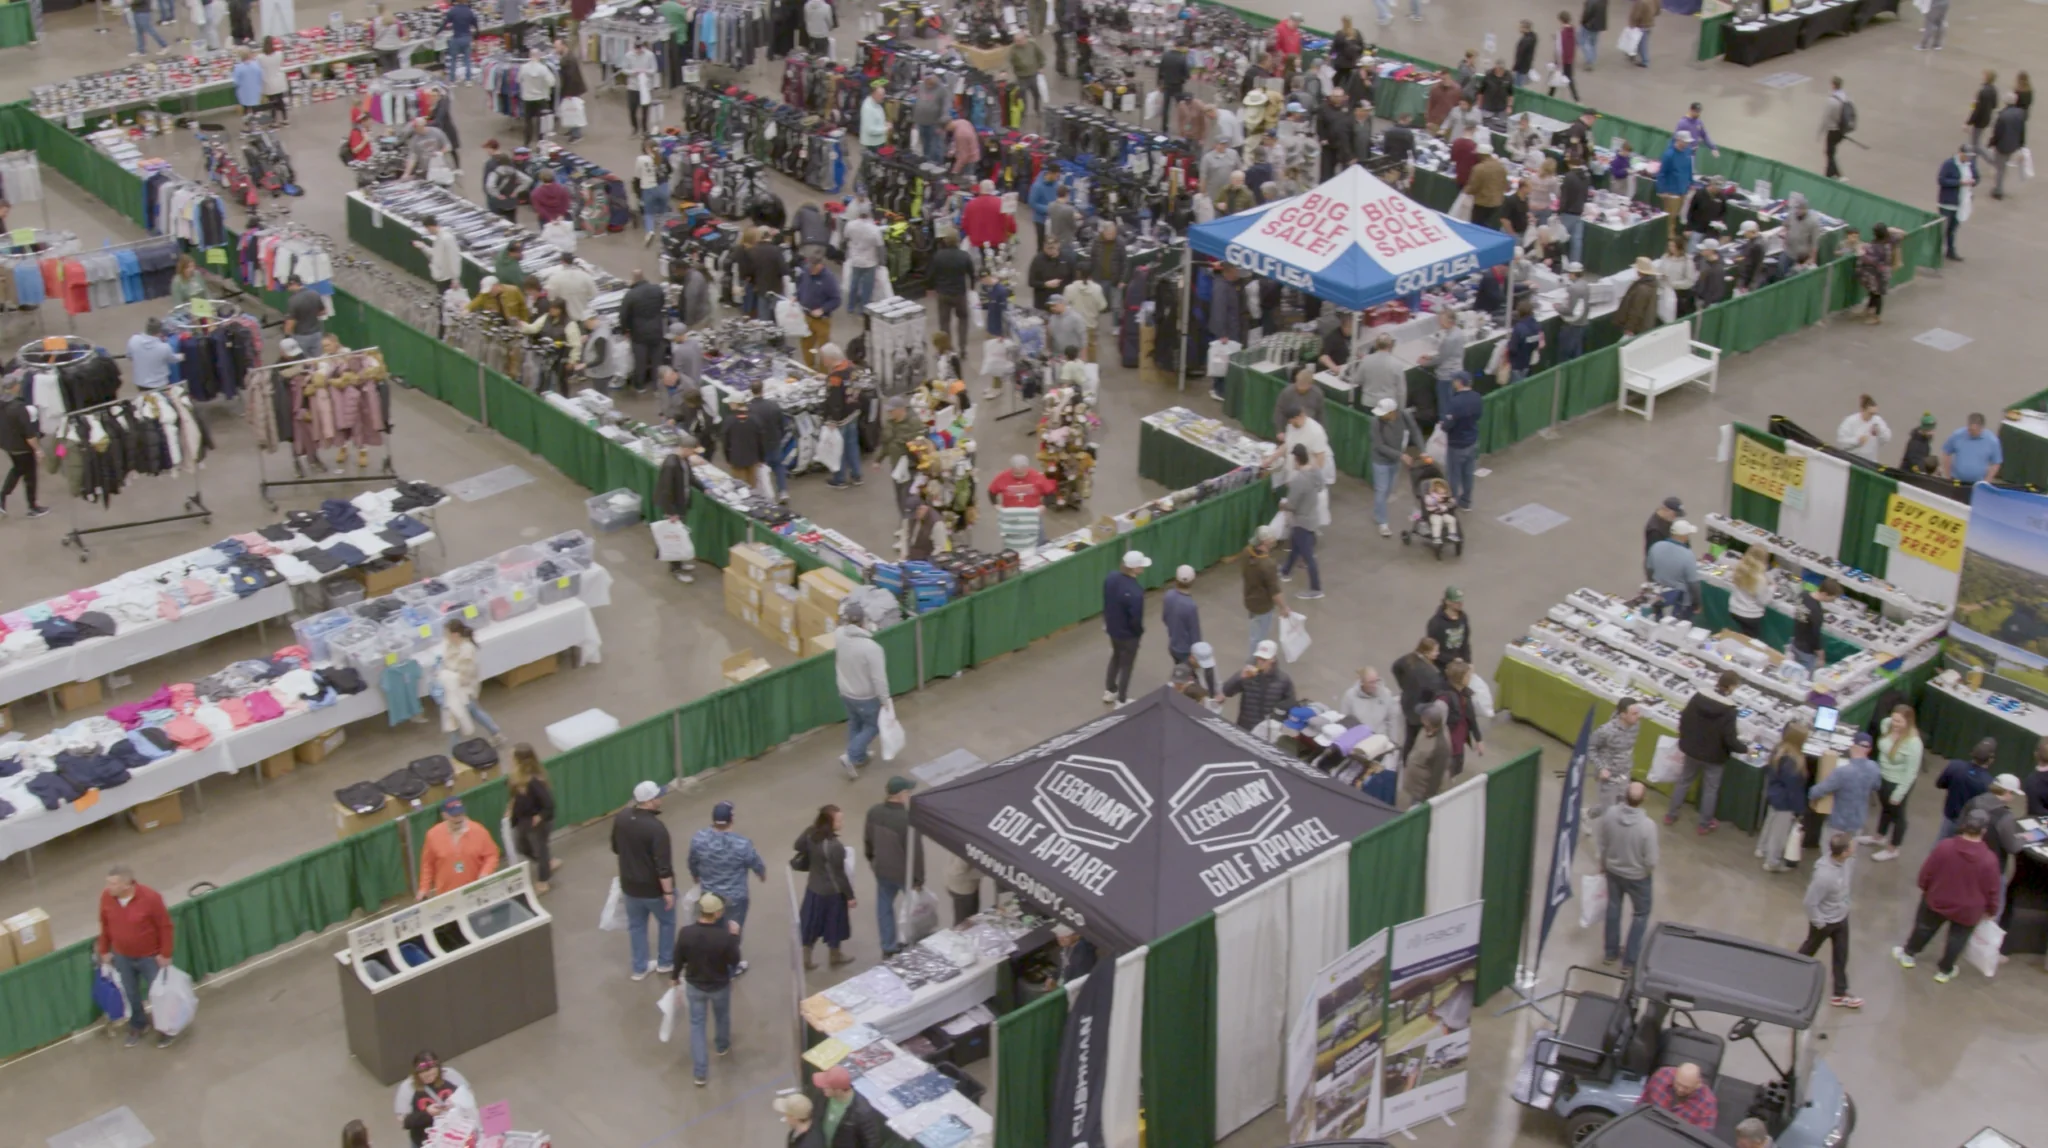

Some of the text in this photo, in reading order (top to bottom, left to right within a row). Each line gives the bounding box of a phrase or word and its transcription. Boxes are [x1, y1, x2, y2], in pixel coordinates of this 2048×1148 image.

[1279, 207, 1350, 239] GOLF
[1302, 193, 1349, 221] BIG
[1361, 195, 1407, 222] BIG
[1261, 220, 1338, 257] SALE!
[1366, 209, 1428, 241] GOLF
[1375, 224, 1448, 257] SALE!
[1891, 517, 1922, 535] GET
[1925, 529, 1960, 549] TWO
[1894, 501, 1962, 533] BUY ONE
[1900, 536, 1948, 557] FREE!
[1047, 770, 1139, 831] LEGENDARY
[1182, 778, 1274, 835] LEGENDARY
[987, 805, 1118, 896] GOLF APPAREL
[1199, 817, 1340, 897] GOLF APPAREL
